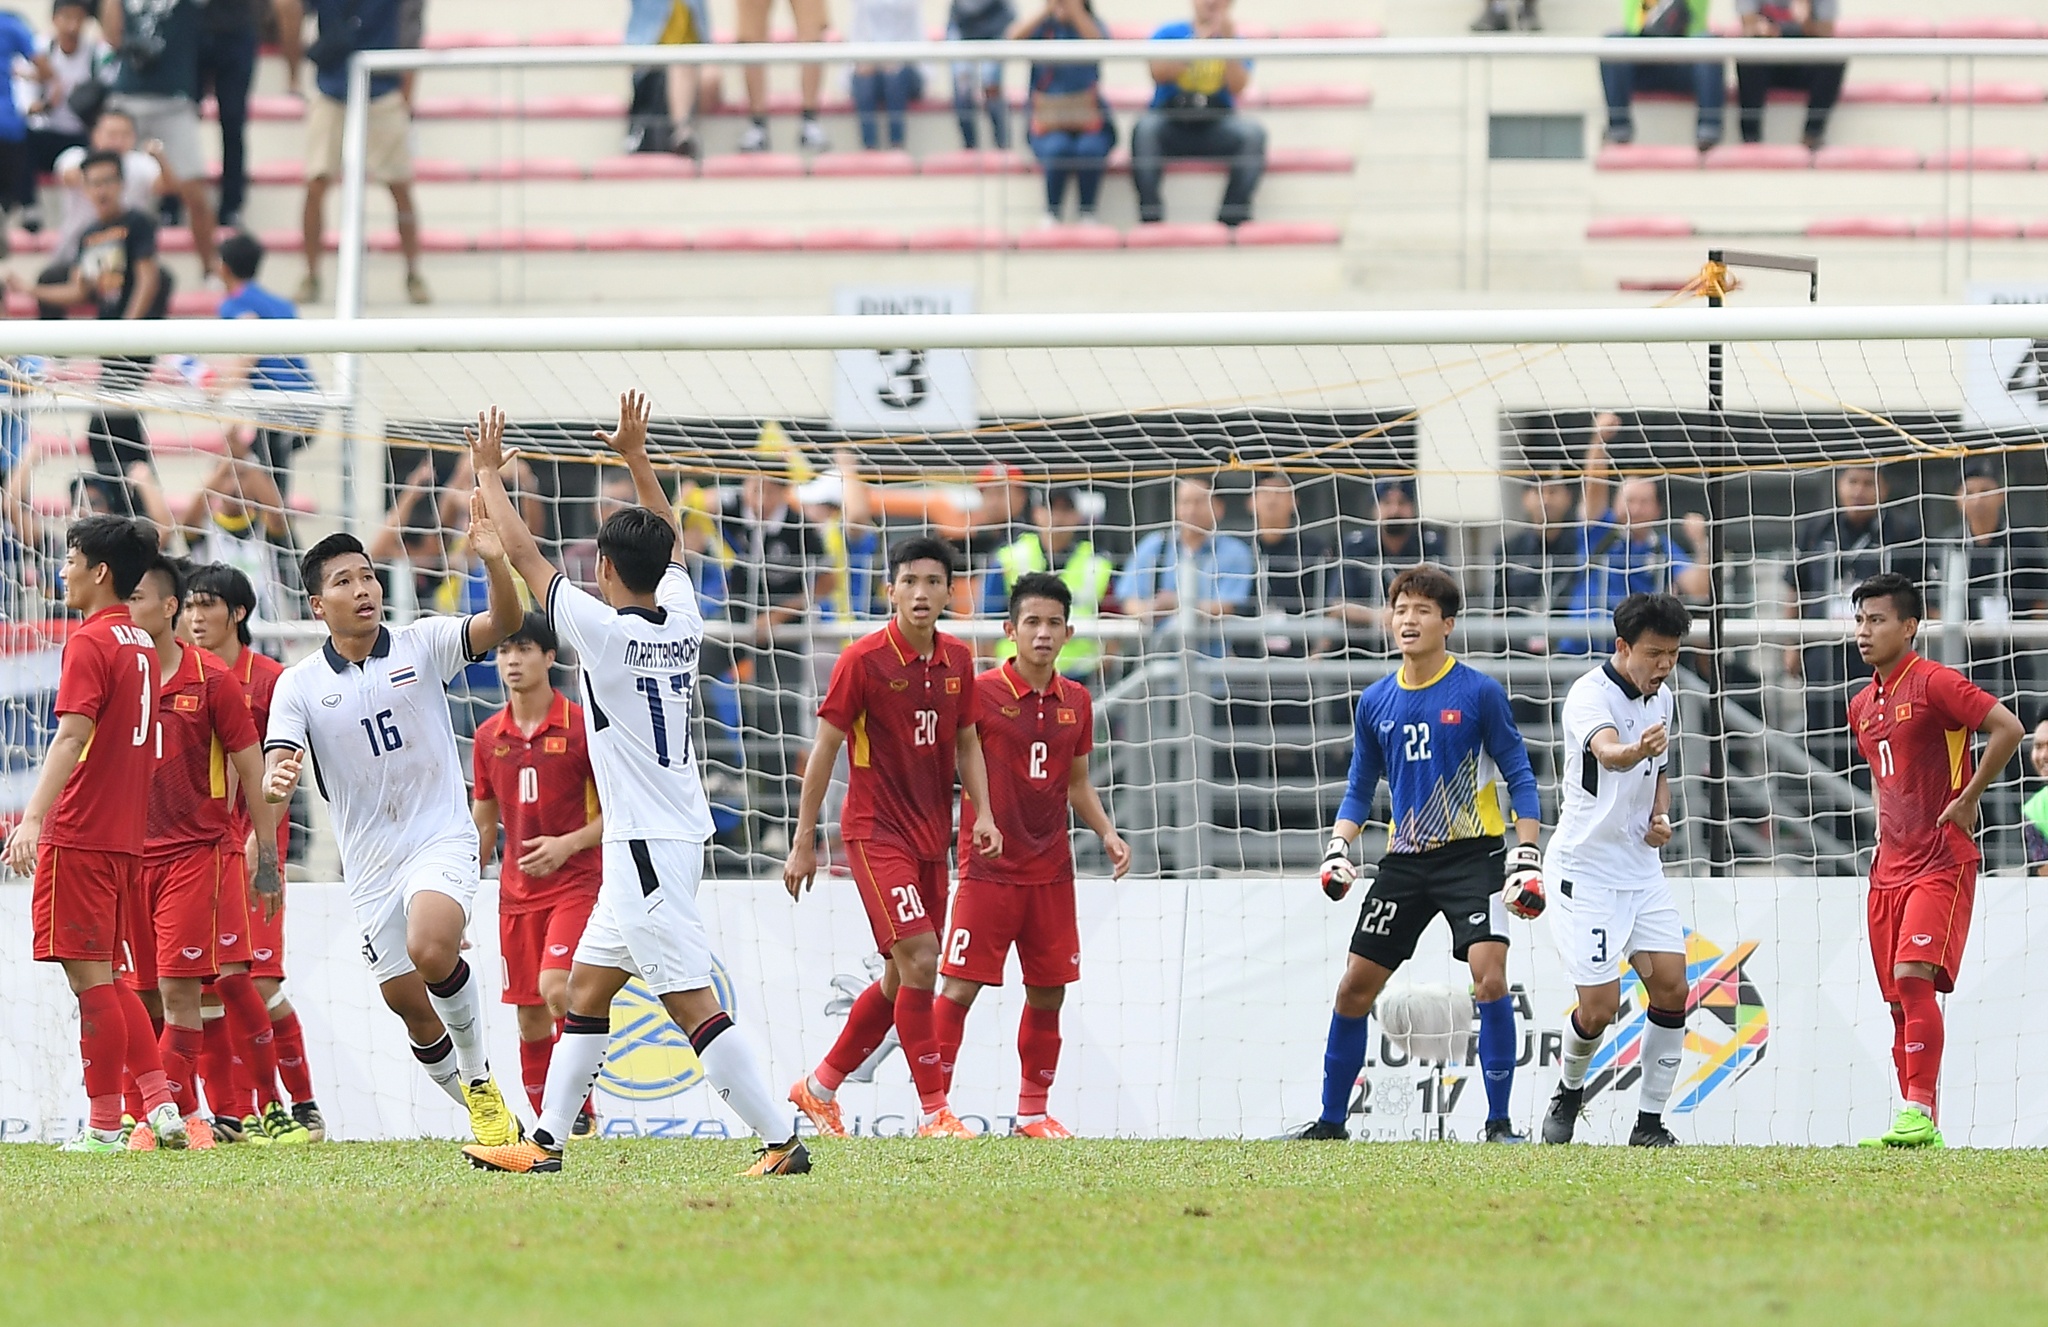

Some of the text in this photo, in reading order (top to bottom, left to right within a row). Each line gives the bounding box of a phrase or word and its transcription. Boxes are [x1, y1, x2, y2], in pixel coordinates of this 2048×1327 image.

[877, 349, 927, 408] 3
[2006, 339, 2048, 406] 4
[132, 651, 151, 746] 3
[360, 708, 403, 757] 16
[635, 672, 692, 768] 17
[914, 710, 938, 746] 20
[1030, 741, 1048, 779] 12
[1403, 722, 1432, 762] 22
[518, 767, 539, 804] 10
[891, 884, 926, 923] 20
[1361, 898, 1397, 936] 22
[1591, 928, 1607, 962] 3
